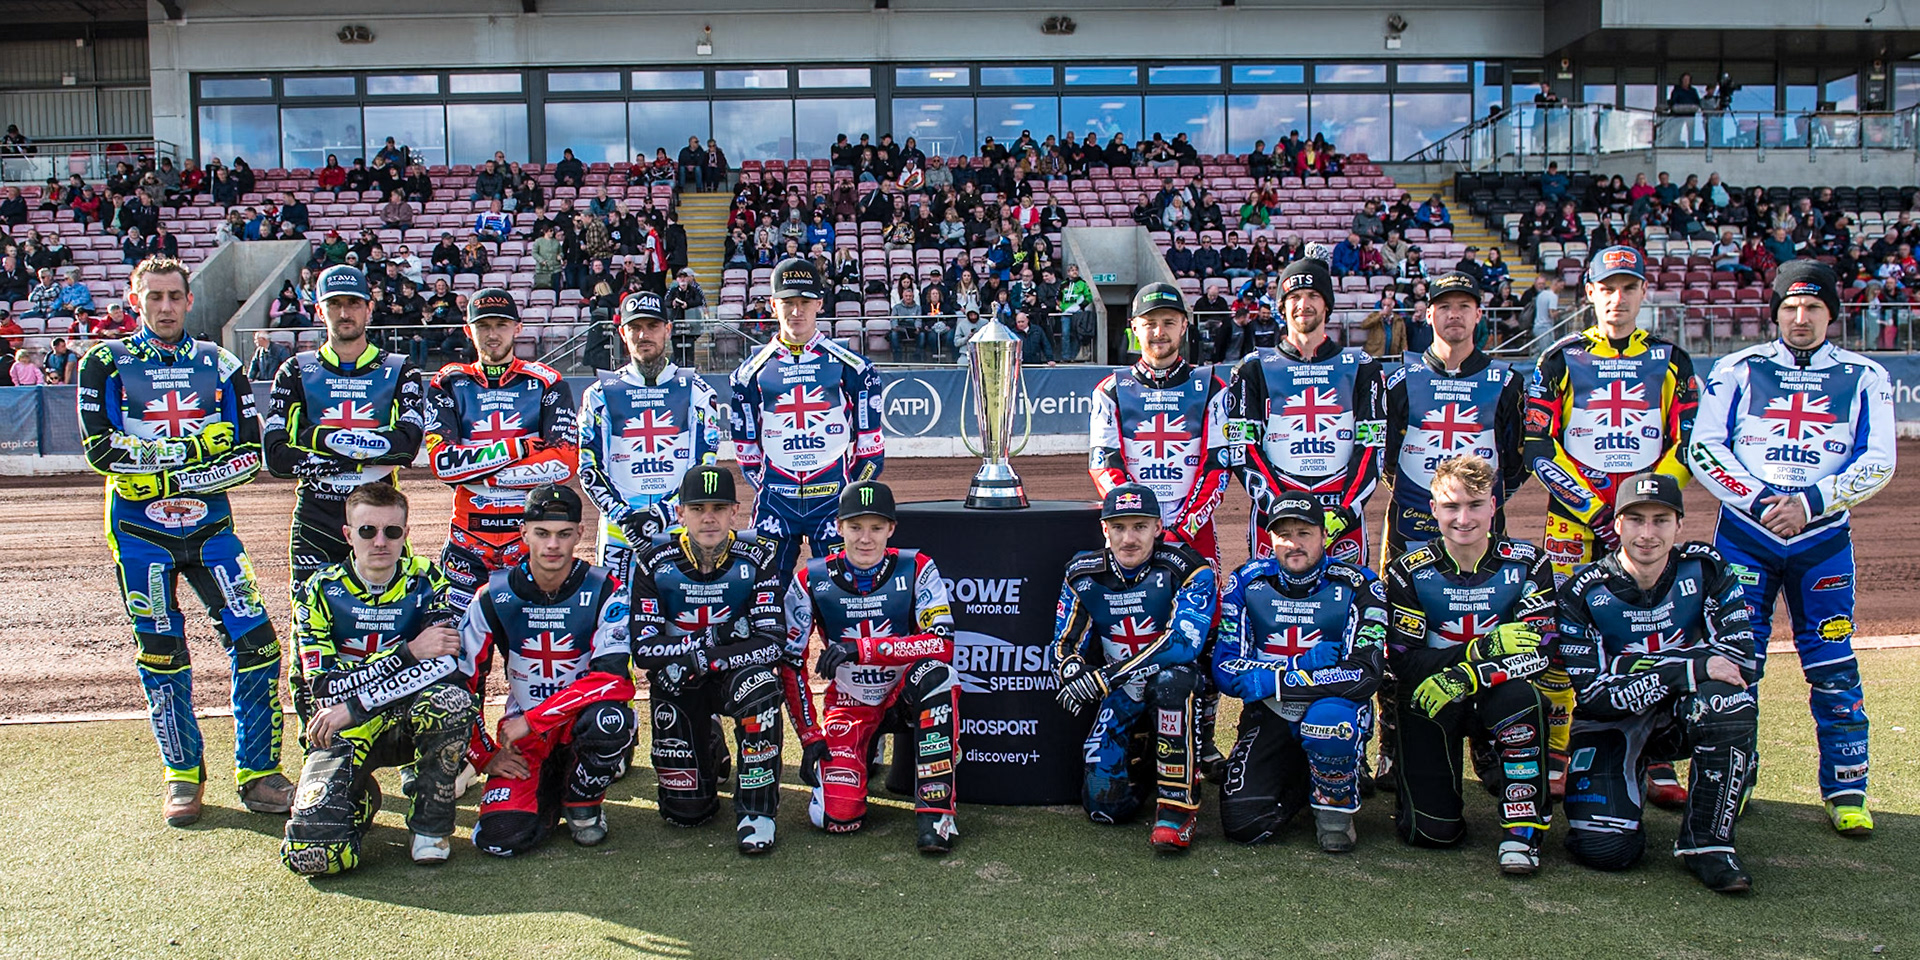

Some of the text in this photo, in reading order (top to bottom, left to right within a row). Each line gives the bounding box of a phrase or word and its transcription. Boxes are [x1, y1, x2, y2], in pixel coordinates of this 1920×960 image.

[1290, 274, 1313, 286] FTS
[1342, 354, 1354, 364] 15
[1651, 349, 1665, 359] 10
[203, 356, 212, 366] 4
[385, 368, 392, 379] 7
[1487, 369, 1500, 381] 16
[1845, 365, 1853, 373] 5
[152, 381, 174, 389] BRITISH
[527, 380, 538, 390] 13
[679, 377, 686, 386] 9
[783, 376, 802, 384] BRITISH
[1195, 380, 1203, 391] 6
[1780, 382, 1803, 390] BRITISH
[1456, 393, 1471, 401] FINAL
[481, 403, 499, 411] BRITISH
[631, 400, 651, 408] BRITISH
[888, 398, 929, 416] ATPI
[784, 432, 826, 450] attis
[1290, 436, 1336, 454] attis
[1594, 431, 1640, 450] attis
[1764, 444, 1820, 464] attis
[496, 462, 566, 478] STAVA
[631, 456, 674, 474] attis
[1140, 462, 1182, 480] attis
[1540, 462, 1595, 498] TOLLEY
[1686, 544, 1721, 562] DAD
[740, 564, 749, 579] 8
[1504, 569, 1519, 584] 14
[895, 576, 907, 591] 11
[1156, 573, 1163, 587] 2
[1572, 568, 1602, 596] MUM
[942, 578, 1021, 603] ROWE
[1679, 578, 1697, 596] 18
[416, 594, 422, 607] 1
[580, 592, 592, 606] 17
[1334, 587, 1342, 601] 3
[966, 604, 1020, 614] MOTOR OIL
[1110, 605, 1145, 615] BRITISH FINAL
[1449, 602, 1490, 611] BRITISH FINAL
[846, 610, 868, 618] BRITISH
[1275, 614, 1315, 624] BRITISH FINAL
[356, 622, 378, 630] BRITISH
[1631, 619, 1673, 632] BRITISH FINAL
[894, 637, 944, 650] KRAJEWSKI
[1506, 652, 1538, 668] VISION
[1510, 658, 1549, 677] PLASTICS
[852, 666, 896, 684] attis
[373, 664, 450, 704] MOTORCYCLES
[268, 678, 283, 762] MOORE
[602, 715, 620, 726] ATPI
[657, 711, 673, 720] ATPI
[958, 720, 1038, 735] UROSPORT
[1083, 708, 1114, 764] Nice
[931, 762, 950, 773] NEB
[1506, 802, 1533, 812] NGK
